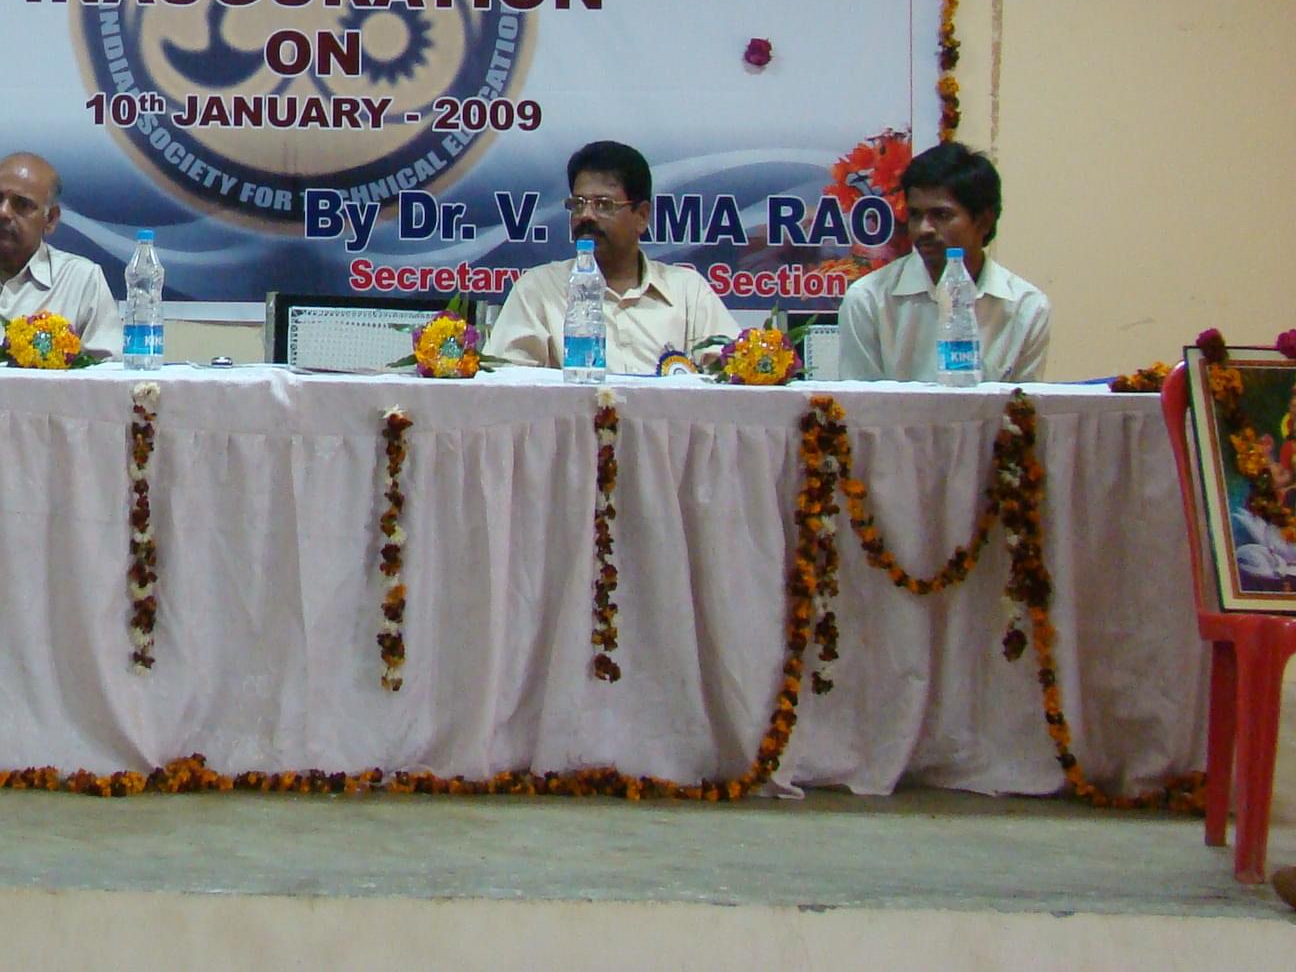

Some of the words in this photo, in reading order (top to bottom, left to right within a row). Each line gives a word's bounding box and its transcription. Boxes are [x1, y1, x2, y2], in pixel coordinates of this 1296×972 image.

[264, 29, 362, 76] ON
[85, 92, 166, 129] 10th
[172, 95, 392, 130] JANUARY
[432, 98, 543, 132] 2009
[98, 4, 140, 97] NDIA
[137, 114, 238, 196] SOCIETY
[239, 182, 292, 211] FOR
[304, 188, 381, 253] By
[399, 190, 477, 242] Dr.
[494, 191, 549, 242] V.
[767, 195, 894, 247] RAO
[707, 262, 848, 298] Section
